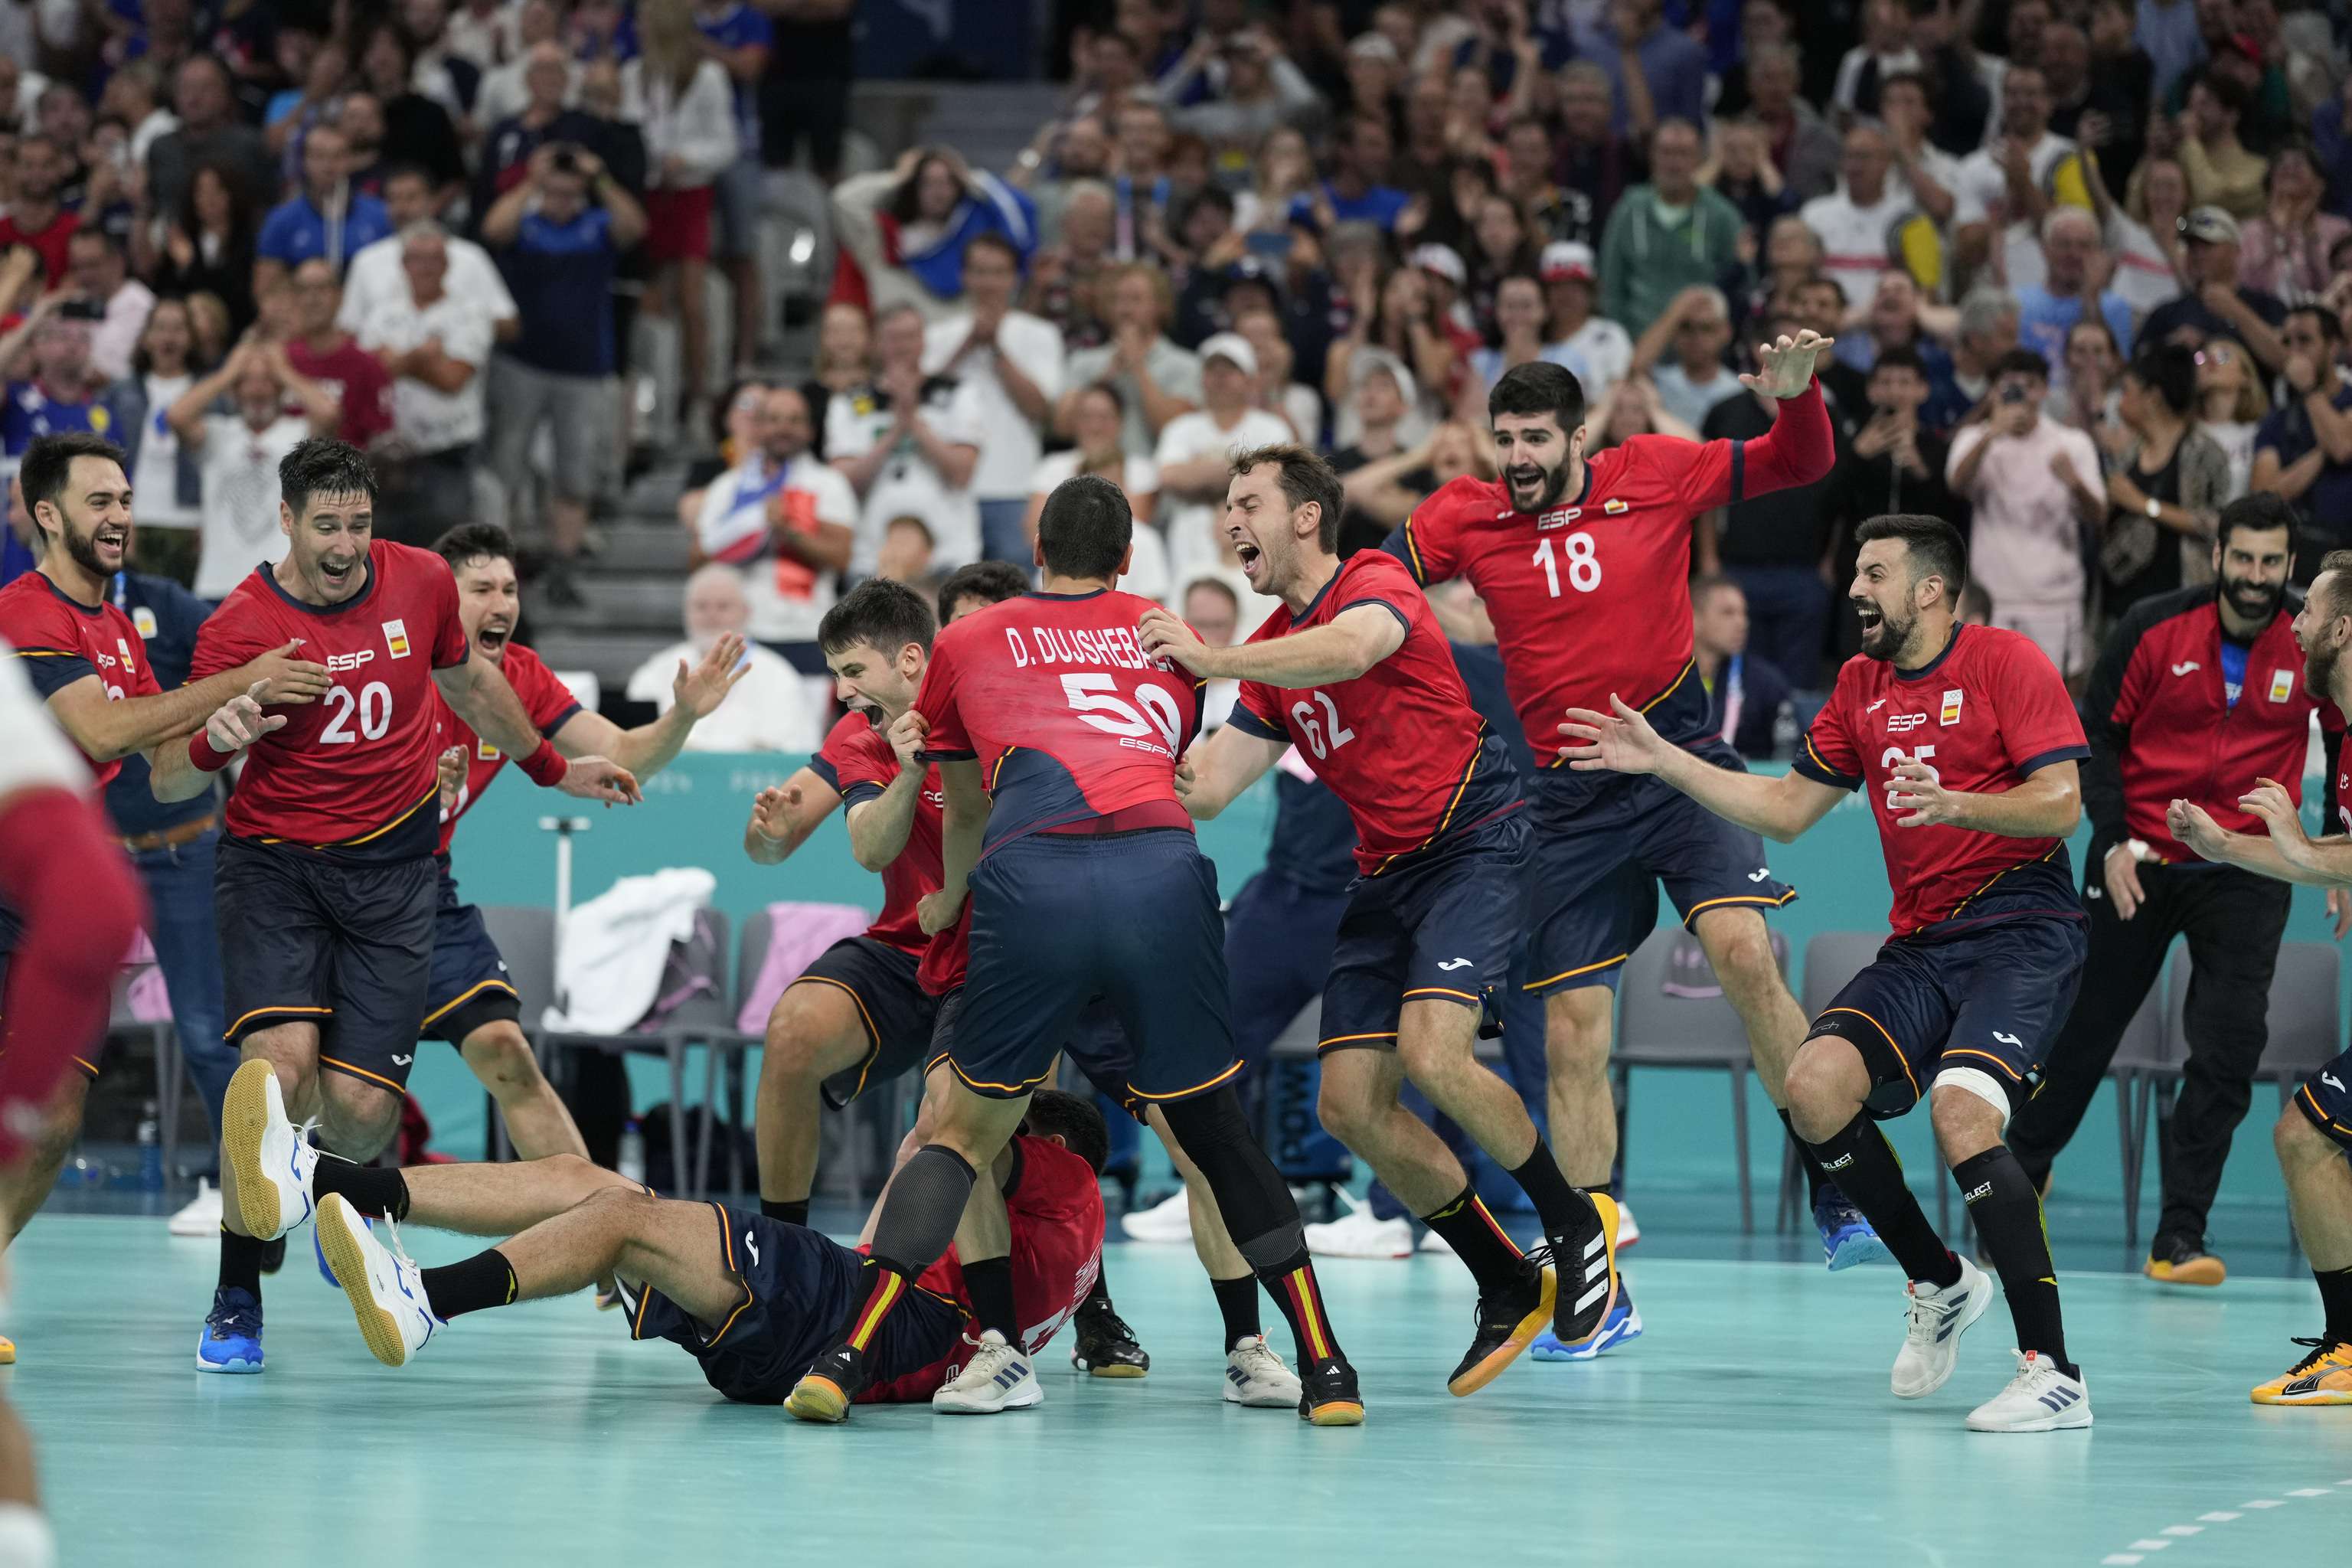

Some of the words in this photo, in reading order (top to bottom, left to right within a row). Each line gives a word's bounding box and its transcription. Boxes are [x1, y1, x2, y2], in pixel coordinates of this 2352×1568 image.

[1537, 507, 1583, 531] ESP
[1532, 531, 1602, 598] 18
[327, 649, 375, 672] ESP
[1005, 627, 1037, 668] D.
[1033, 625, 1174, 672] DUJSHEBA
[318, 681, 393, 744] 20
[1059, 673, 1182, 758] 50
[1291, 690, 1356, 760] 62
[1886, 713, 1927, 733] ESP
[1964, 1181, 1991, 1202] SELECT
